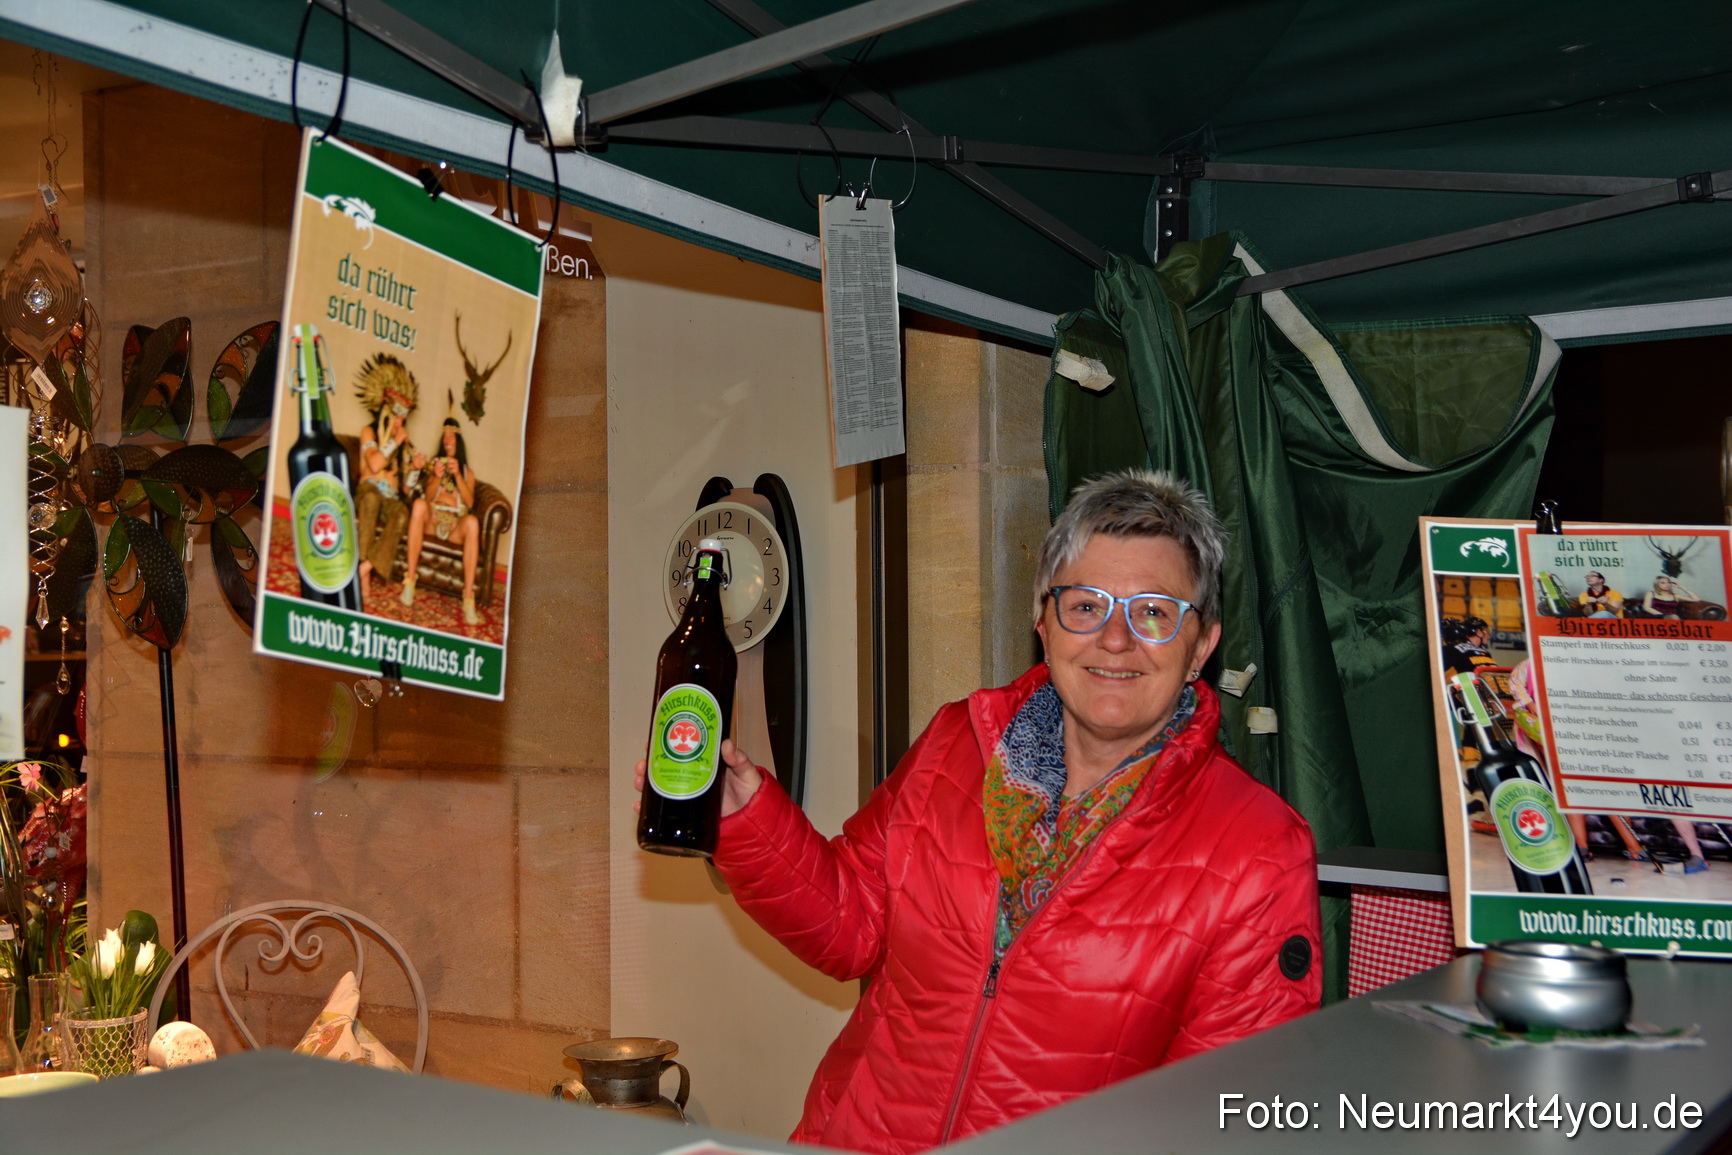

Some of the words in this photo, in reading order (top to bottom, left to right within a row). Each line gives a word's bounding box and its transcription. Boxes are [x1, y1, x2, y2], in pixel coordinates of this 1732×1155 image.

[338, 253, 361, 288] da
[367, 267, 416, 311] rührt
[327, 293, 367, 331] sich
[373, 309, 417, 351] was!
[697, 519, 707, 536] 11
[718, 511, 732, 529] 12
[747, 518, 750, 535] 1
[678, 540, 691, 557] 10
[763, 538, 772, 555] 2
[1557, 538, 1575, 551] da
[1579, 538, 1618, 551] rührt
[1555, 554, 1585, 567] sich
[1589, 555, 1624, 568] was!
[672, 570, 681, 588] 9
[771, 568, 780, 586] 3
[763, 598, 772, 614] 4
[743, 621, 752, 638] 5
[1557, 617, 1714, 639] Hirschkussbar
[288, 610, 484, 681] www.Hirschkuss.de
[1541, 639, 1581, 650] Stamperl
[1583, 641, 1598, 650] mit
[1601, 641, 1650, 650] Hirschkuss
[1543, 655, 1569, 664] Heißer
[1571, 657, 1613, 666] Hirschkuss
[1622, 658, 1645, 666] Sahne
[1624, 674, 1647, 682] ohne
[1650, 675, 1677, 683] Sahne
[1547, 688, 1567, 697] Zum
[1629, 692, 1646, 700] das
[1648, 692, 1688, 701] schönste
[660, 694, 716, 721] Hirschkuss
[1555, 731, 1580, 740] Halbe
[1582, 732, 1603, 741] Liter
[1606, 733, 1639, 743] Flasche
[1636, 752, 1670, 761] Flasche
[1560, 762, 1600, 772] Ein-Liter
[1602, 765, 1635, 775] Flasche
[1564, 785, 1623, 797] Willkommen
[1625, 789, 1638, 797] im
[1639, 784, 1693, 808] RACKL
